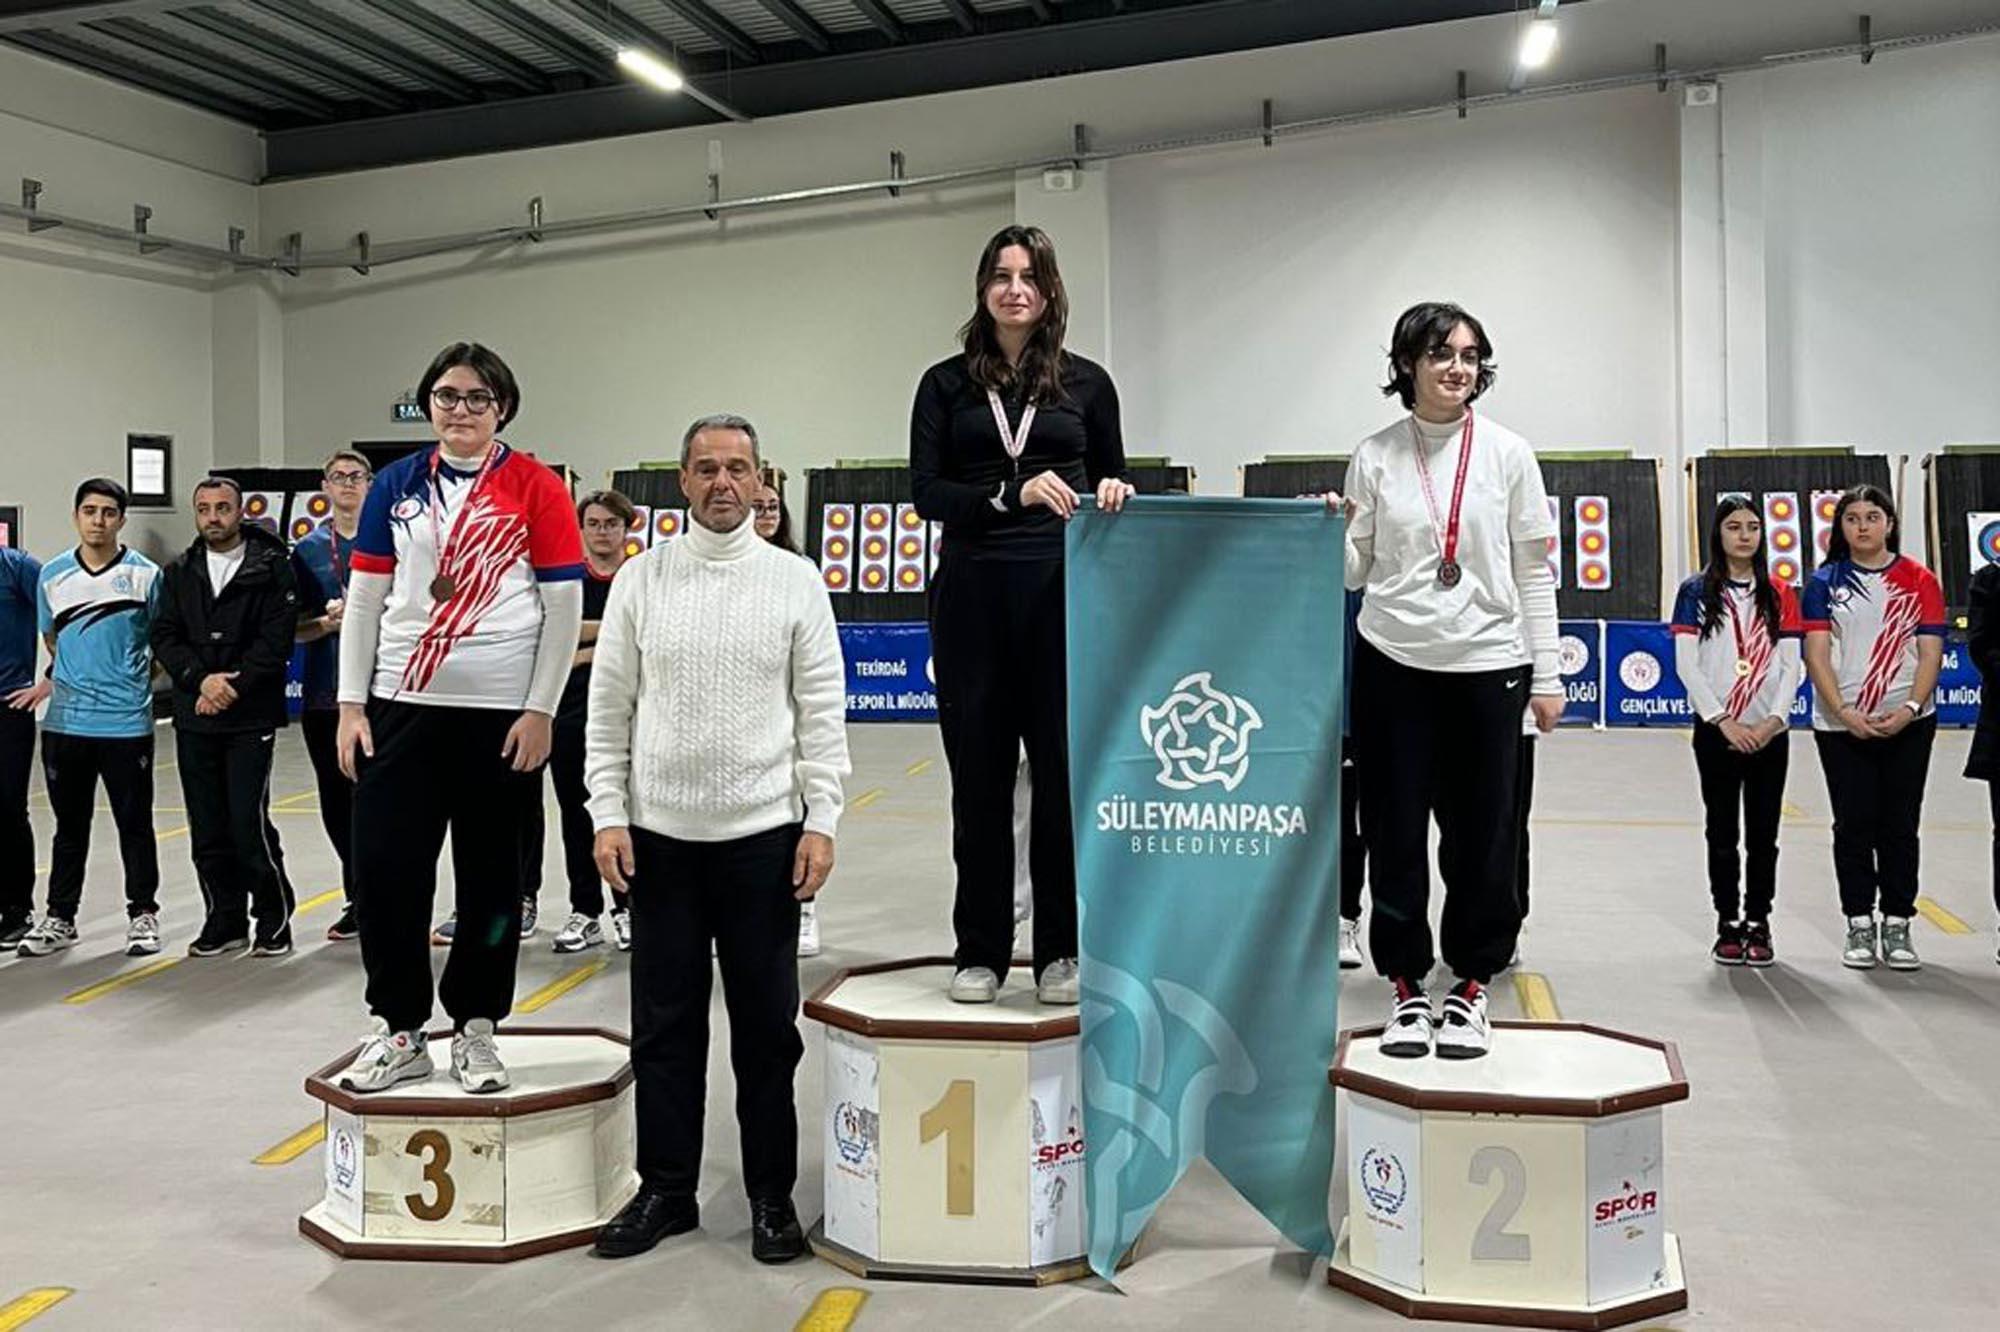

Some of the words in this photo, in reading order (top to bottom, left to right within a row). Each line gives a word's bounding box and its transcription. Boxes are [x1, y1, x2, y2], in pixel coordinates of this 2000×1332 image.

[855, 658, 907, 677] TEKİRDAĞ
[858, 694, 885, 710] SPOR
[886, 691, 896, 710] İL
[1620, 695, 1669, 717] GENÇLİK
[1670, 699, 1685, 714] VE
[1096, 794, 1308, 838] SÜLEYMANPAŞA
[1131, 834, 1271, 856] BELEDİYESİ
[919, 1079, 976, 1217] 1
[404, 1129, 456, 1222] 3
[1468, 1145, 1532, 1262] 2
[1595, 1190, 1657, 1221] SPOR
